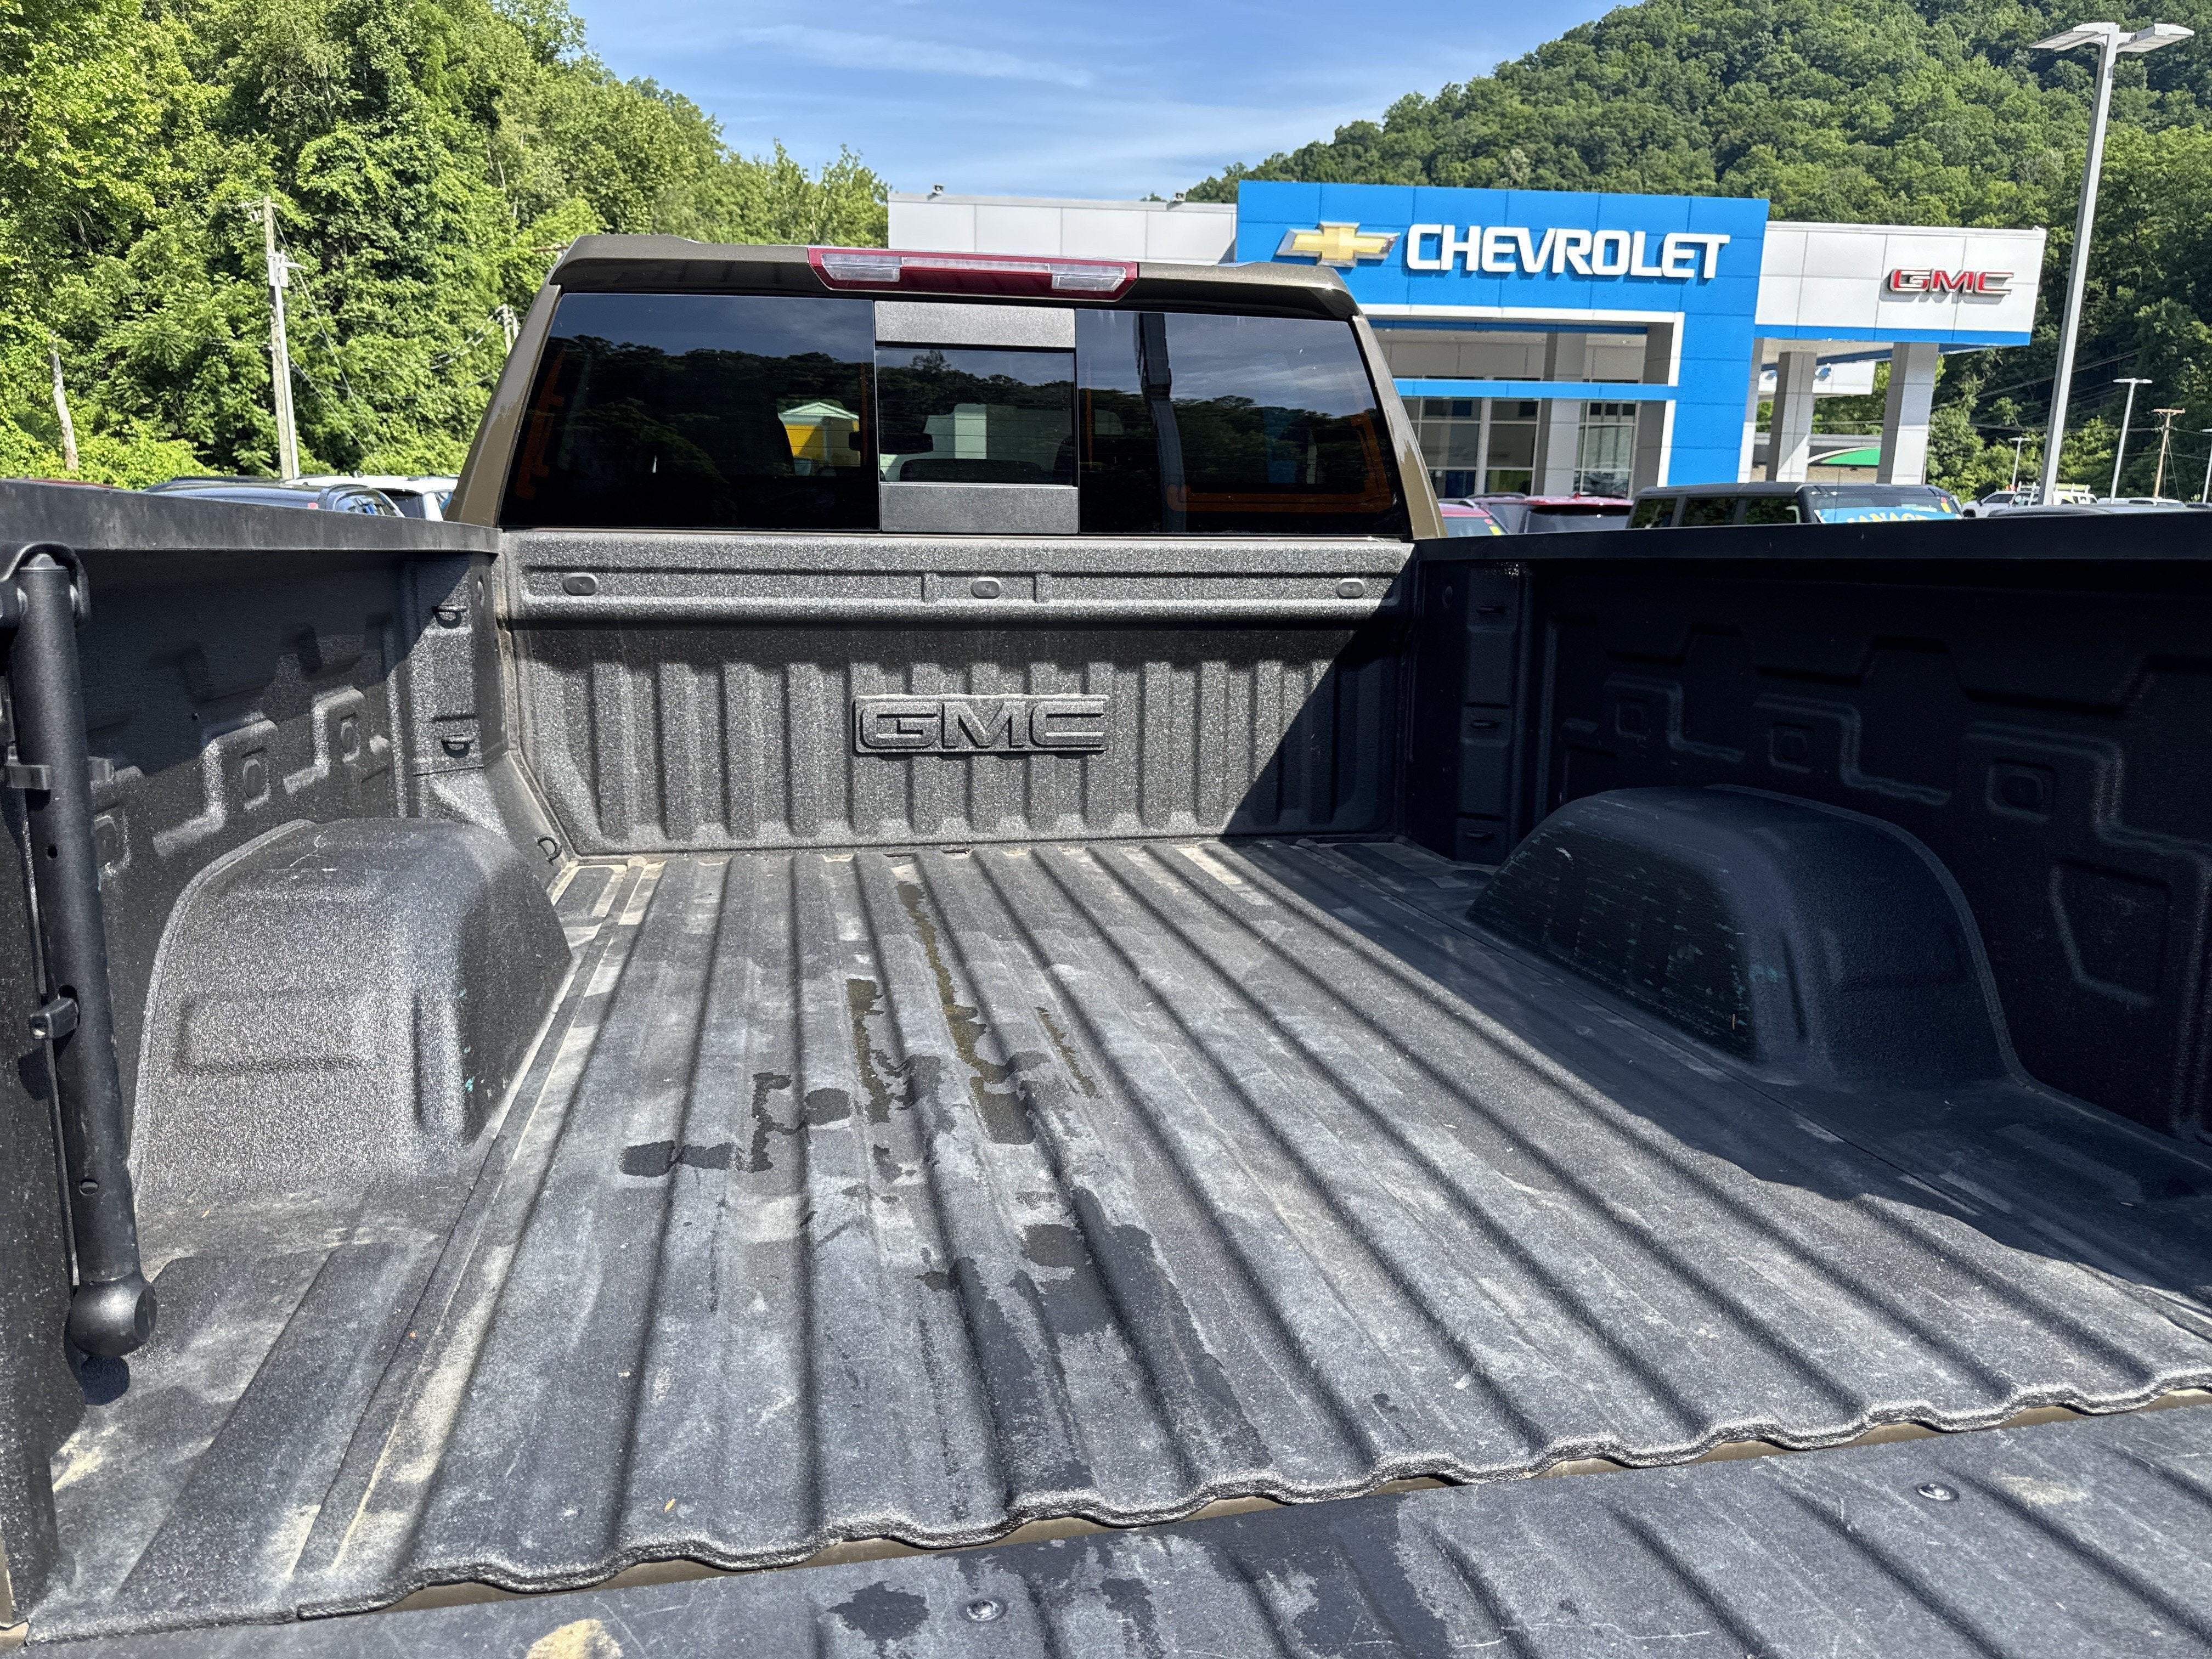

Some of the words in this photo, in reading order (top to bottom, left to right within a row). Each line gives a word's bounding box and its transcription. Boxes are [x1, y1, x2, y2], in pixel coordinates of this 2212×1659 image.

[1407, 223, 1730, 279] CHEVROLET
[1890, 267, 2015, 295] GMC
[859, 702, 1105, 749] GMC
